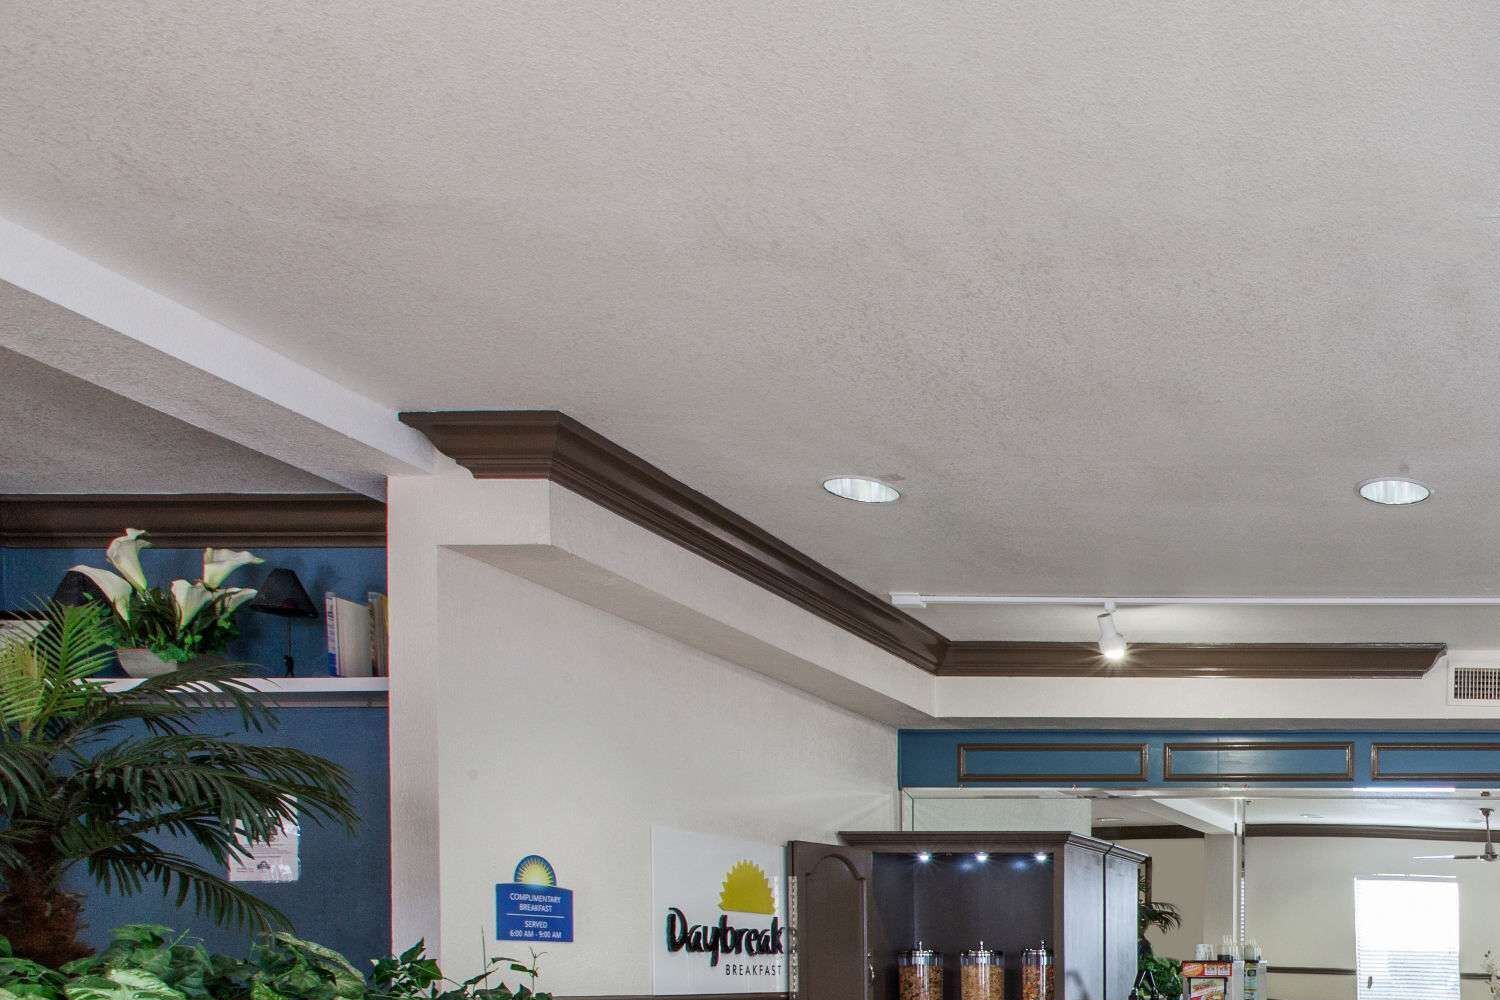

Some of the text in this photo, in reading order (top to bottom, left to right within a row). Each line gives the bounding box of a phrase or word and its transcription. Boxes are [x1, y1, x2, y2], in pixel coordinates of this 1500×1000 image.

[509, 892, 561, 904] COMPLIMENTARY
[519, 903, 553, 912] BREAKFAST
[524, 920, 548, 929] SERVED
[523, 930, 534, 938] AM
[552, 931, 562, 939] AM
[666, 907, 785, 967] Daybreak
[725, 964, 782, 976] BREAKFAST
